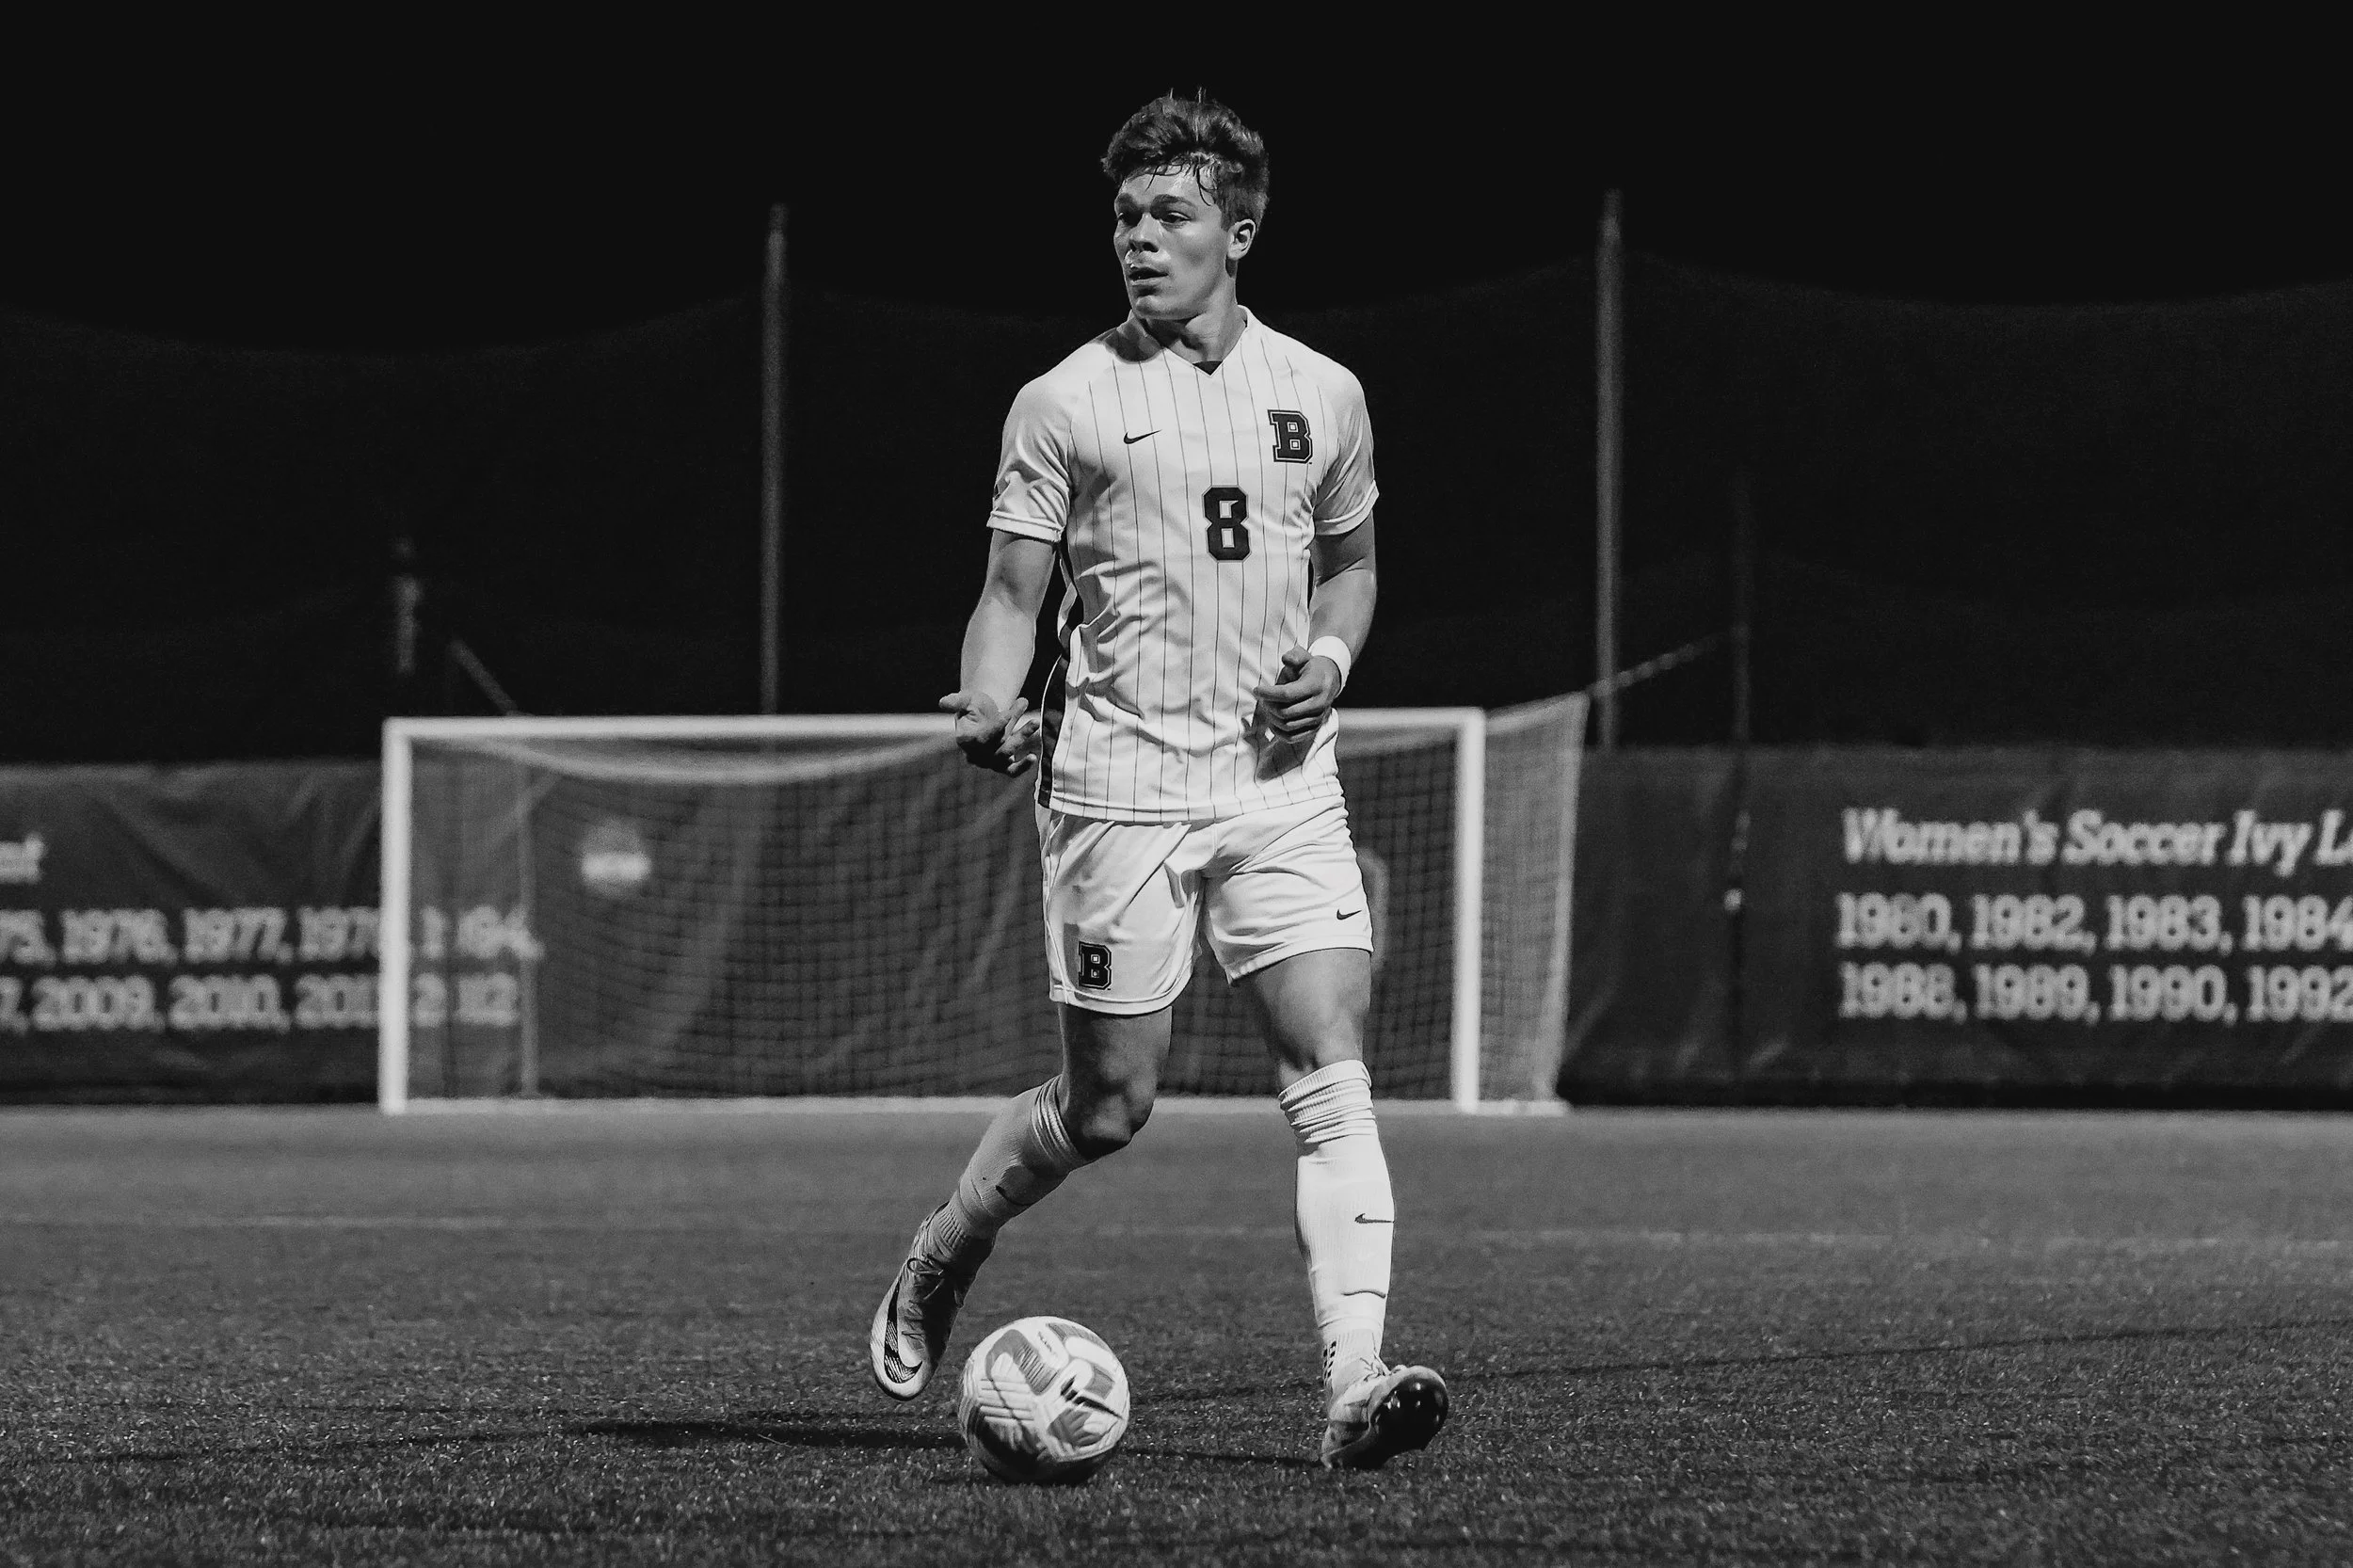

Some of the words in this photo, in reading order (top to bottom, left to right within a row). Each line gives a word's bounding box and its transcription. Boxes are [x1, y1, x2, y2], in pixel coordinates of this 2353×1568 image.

[1267, 408, 1313, 463] B
[1202, 485, 1251, 563] 8
[1843, 808, 2059, 865] Women's
[2062, 808, 2225, 866] Soccer
[2225, 809, 2313, 877] Ivy
[1836, 892, 1961, 952] 1980,
[1971, 894, 2096, 953] 1982,
[2105, 894, 2233, 954] 1983,
[1078, 941, 1112, 990] B
[1841, 963, 1967, 1022] 1988,
[1974, 965, 2101, 1023] 1989,
[2109, 965, 2237, 1024] 1990,
